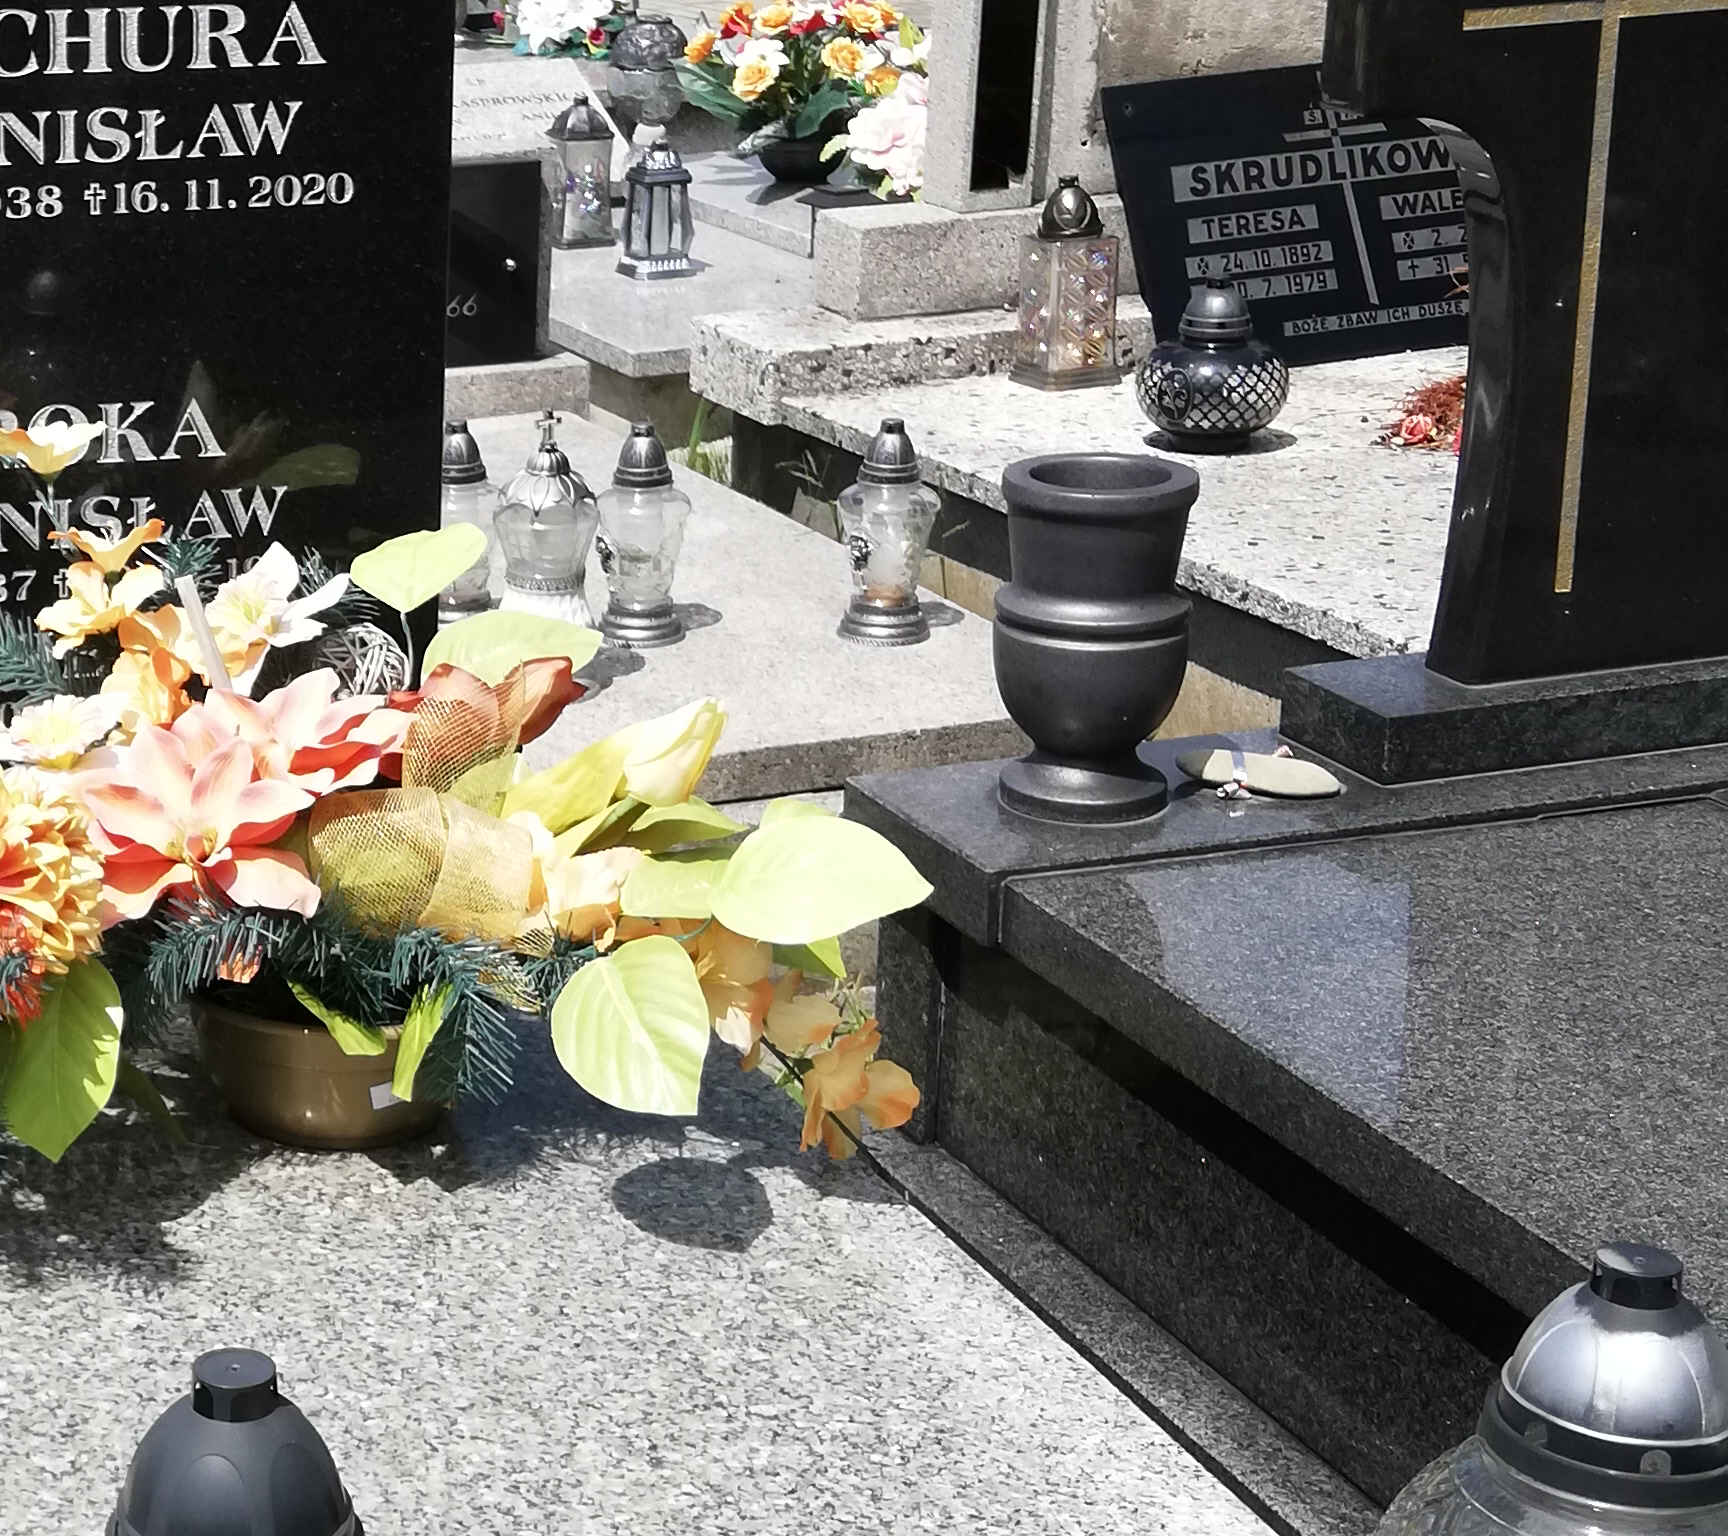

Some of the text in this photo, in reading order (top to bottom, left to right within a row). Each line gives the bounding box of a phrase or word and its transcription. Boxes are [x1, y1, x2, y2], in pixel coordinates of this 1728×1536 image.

[248, 172, 354, 208] 2020
[1201, 208, 1306, 239] TERESA
[1285, 271, 1328, 293] 1979
[1336, 309, 1379, 330] ZBAW
[1387, 307, 1411, 322] ICH
